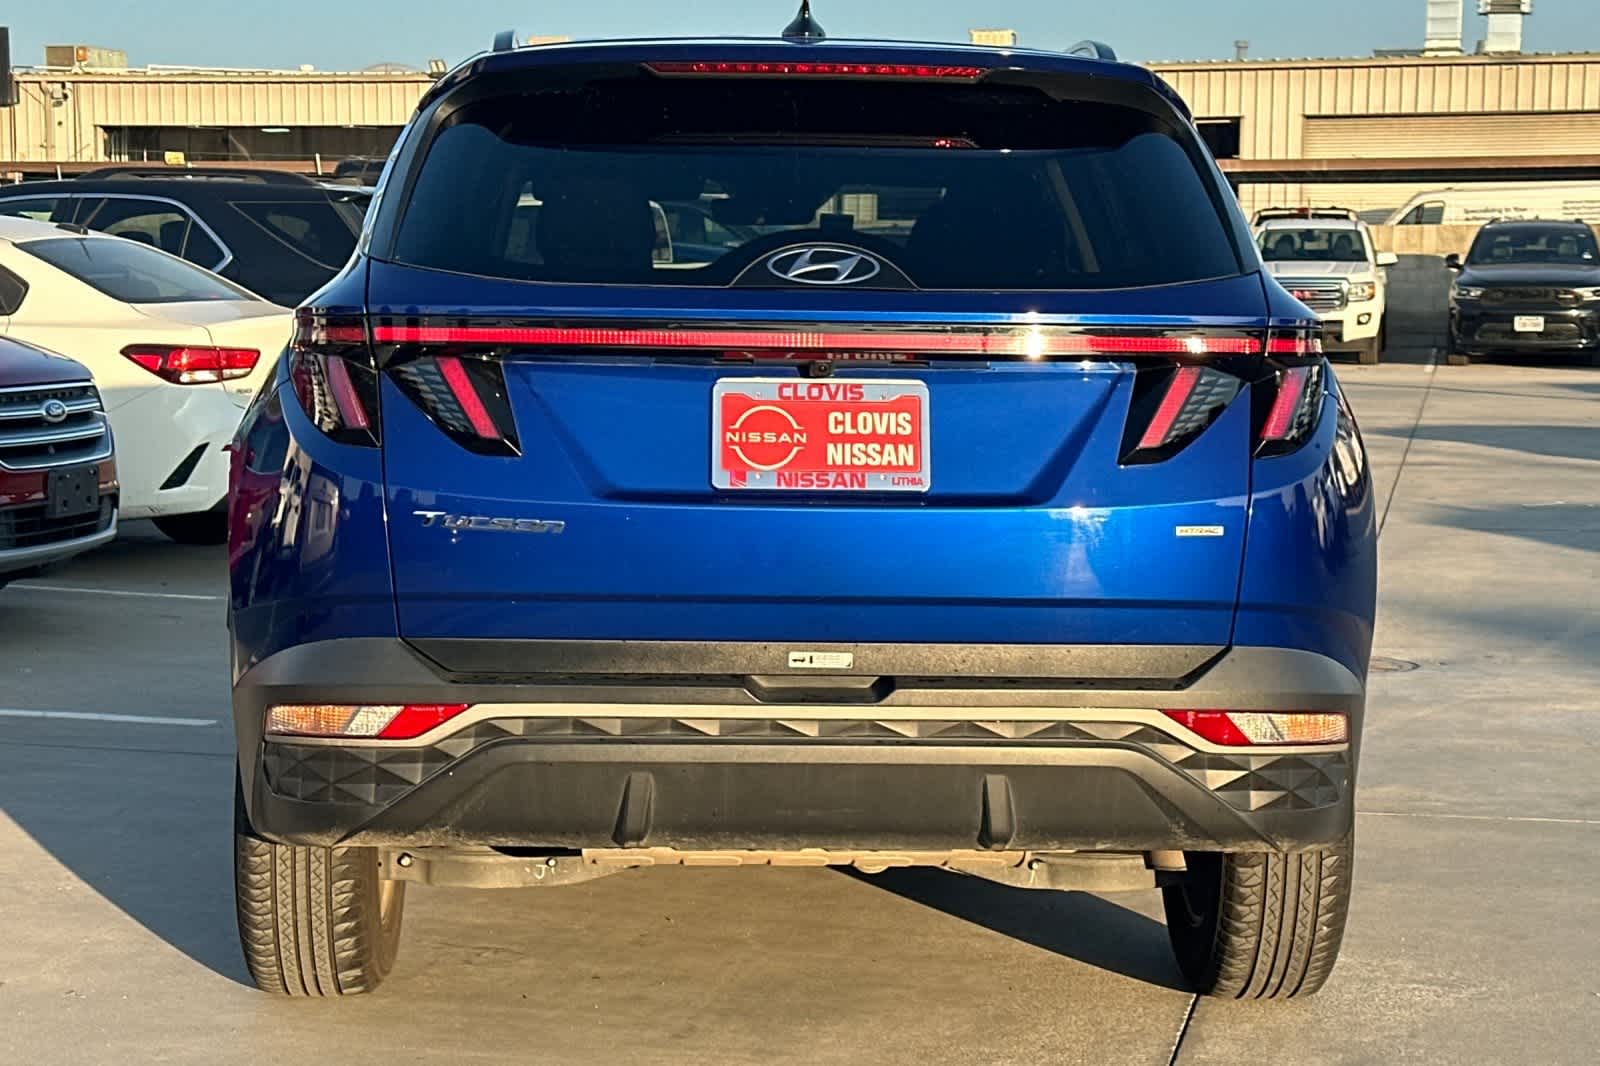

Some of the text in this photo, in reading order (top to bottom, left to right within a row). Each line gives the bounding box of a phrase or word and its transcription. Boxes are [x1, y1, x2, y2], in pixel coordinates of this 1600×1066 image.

[778, 382, 864, 401] CLOVIS
[828, 411, 912, 436] CLOVIS
[725, 431, 808, 444] NISSAN
[826, 442, 914, 466] NISSAN
[776, 472, 867, 489] NISSAN
[891, 476, 924, 487] LITHIA
